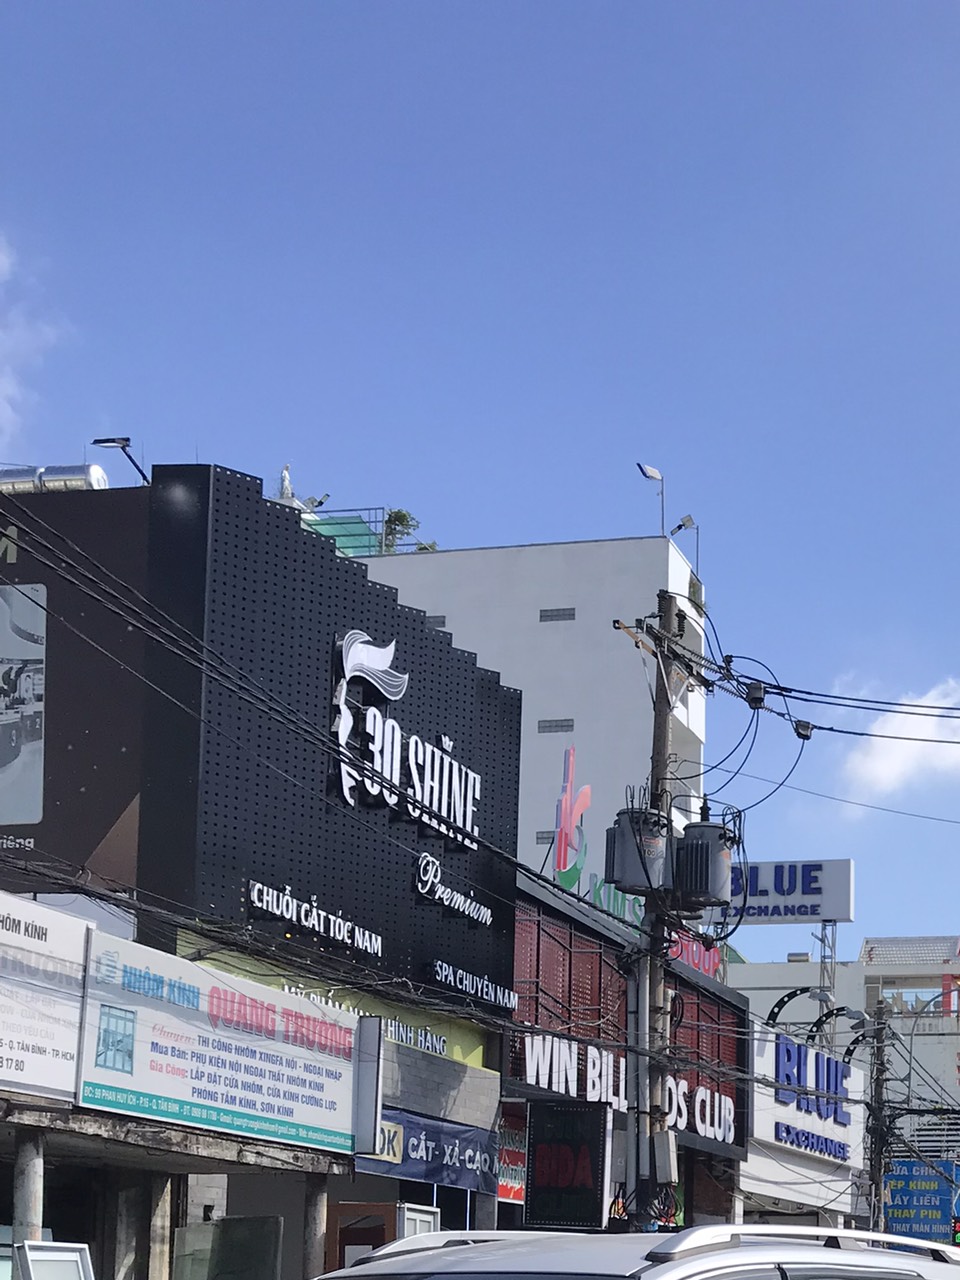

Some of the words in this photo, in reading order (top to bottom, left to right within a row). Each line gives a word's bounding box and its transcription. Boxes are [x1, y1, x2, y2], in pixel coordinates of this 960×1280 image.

[417, 852, 493, 926] Premium
[731, 864, 822, 897] BLUE
[254, 882, 297, 922] CHUỖI
[300, 895, 326, 933] CẮT
[328, 909, 351, 944] TÓC
[353, 926, 382, 957] NAM
[720, 904, 821, 918] EXCHANGE
[23, 920, 48, 943] KÍNH
[435, 959, 455, 986] SPA
[456, 968, 495, 1003] CHUYÊN
[495, 988, 519, 1011] NAM
[208, 985, 277, 1040] QUANG
[61, 1050, 75, 1062] HCM
[150, 1041, 169, 1056] Mua
[387, 1016, 415, 1045] HÍNH
[417, 1026, 447, 1056] HÀNG
[525, 1034, 578, 1098] WIN
[694, 1086, 735, 1145] CLUB
[775, 1033, 851, 1127] BLUE
[774, 1121, 851, 1162] EXCHANGE
[887, 1208, 917, 1218] THAY
[920, 1209, 942, 1219] PIN
